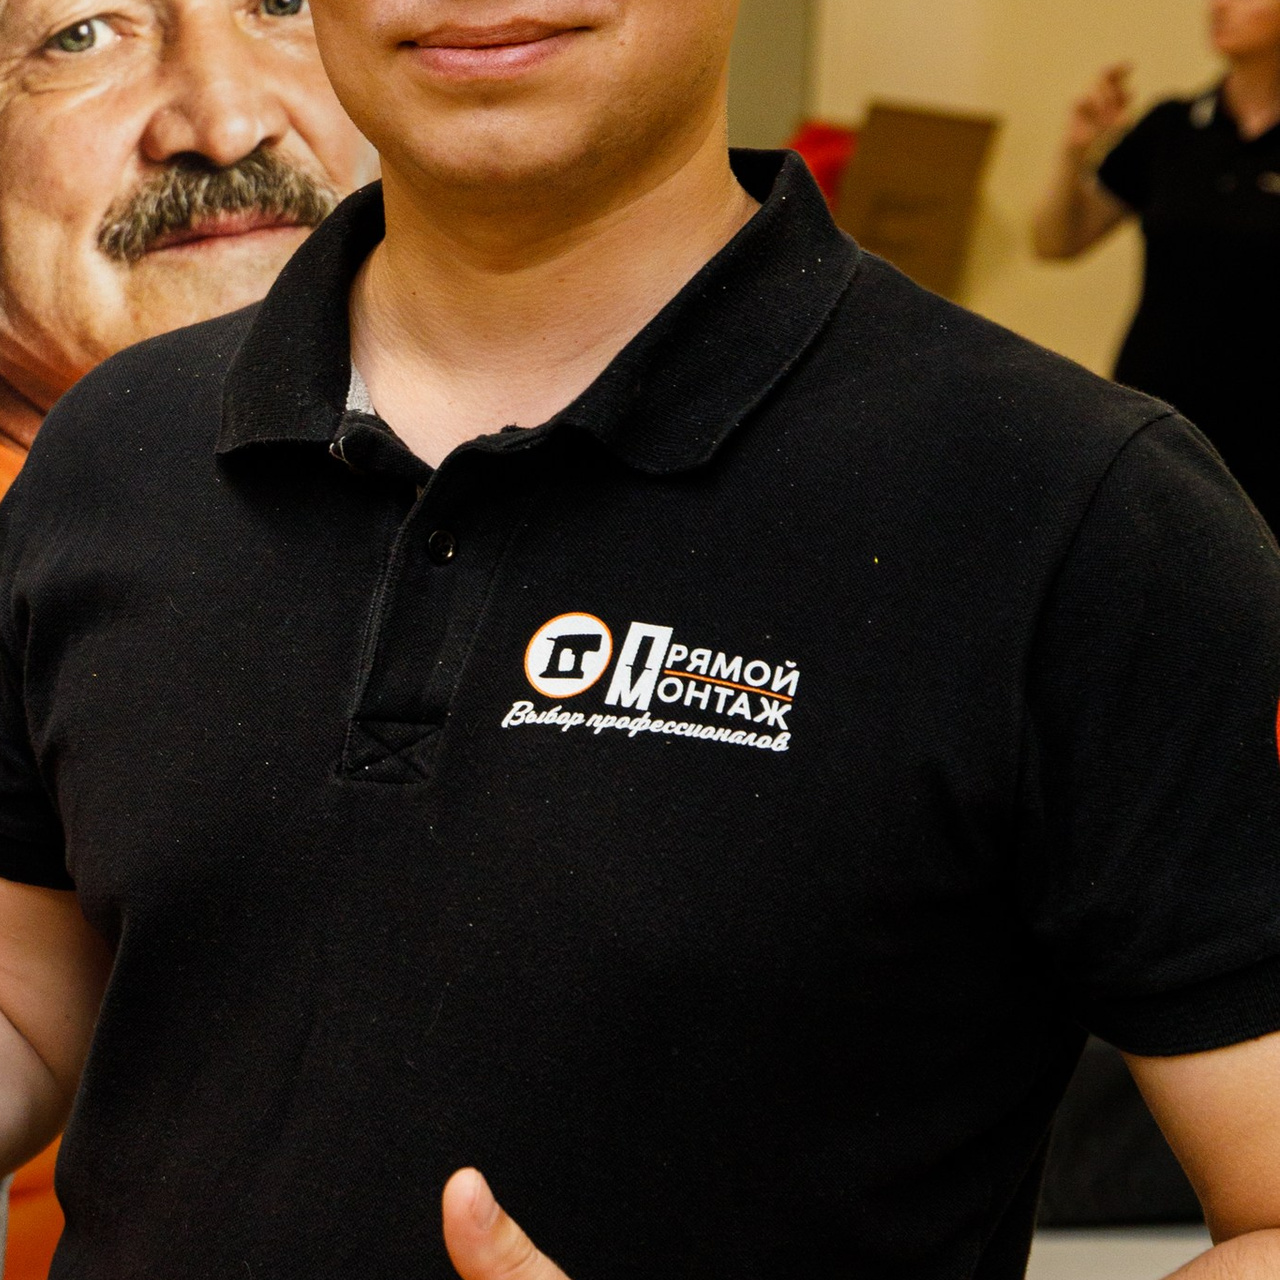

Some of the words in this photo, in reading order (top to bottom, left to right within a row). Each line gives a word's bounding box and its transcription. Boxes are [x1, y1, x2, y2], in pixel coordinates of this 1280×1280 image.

[625, 621, 800, 696] ПРЯМОЙ
[501, 701, 586, 732] Выбор
[586, 712, 791, 752] профессионалов
[604, 664, 792, 730] МОНТАЖ
